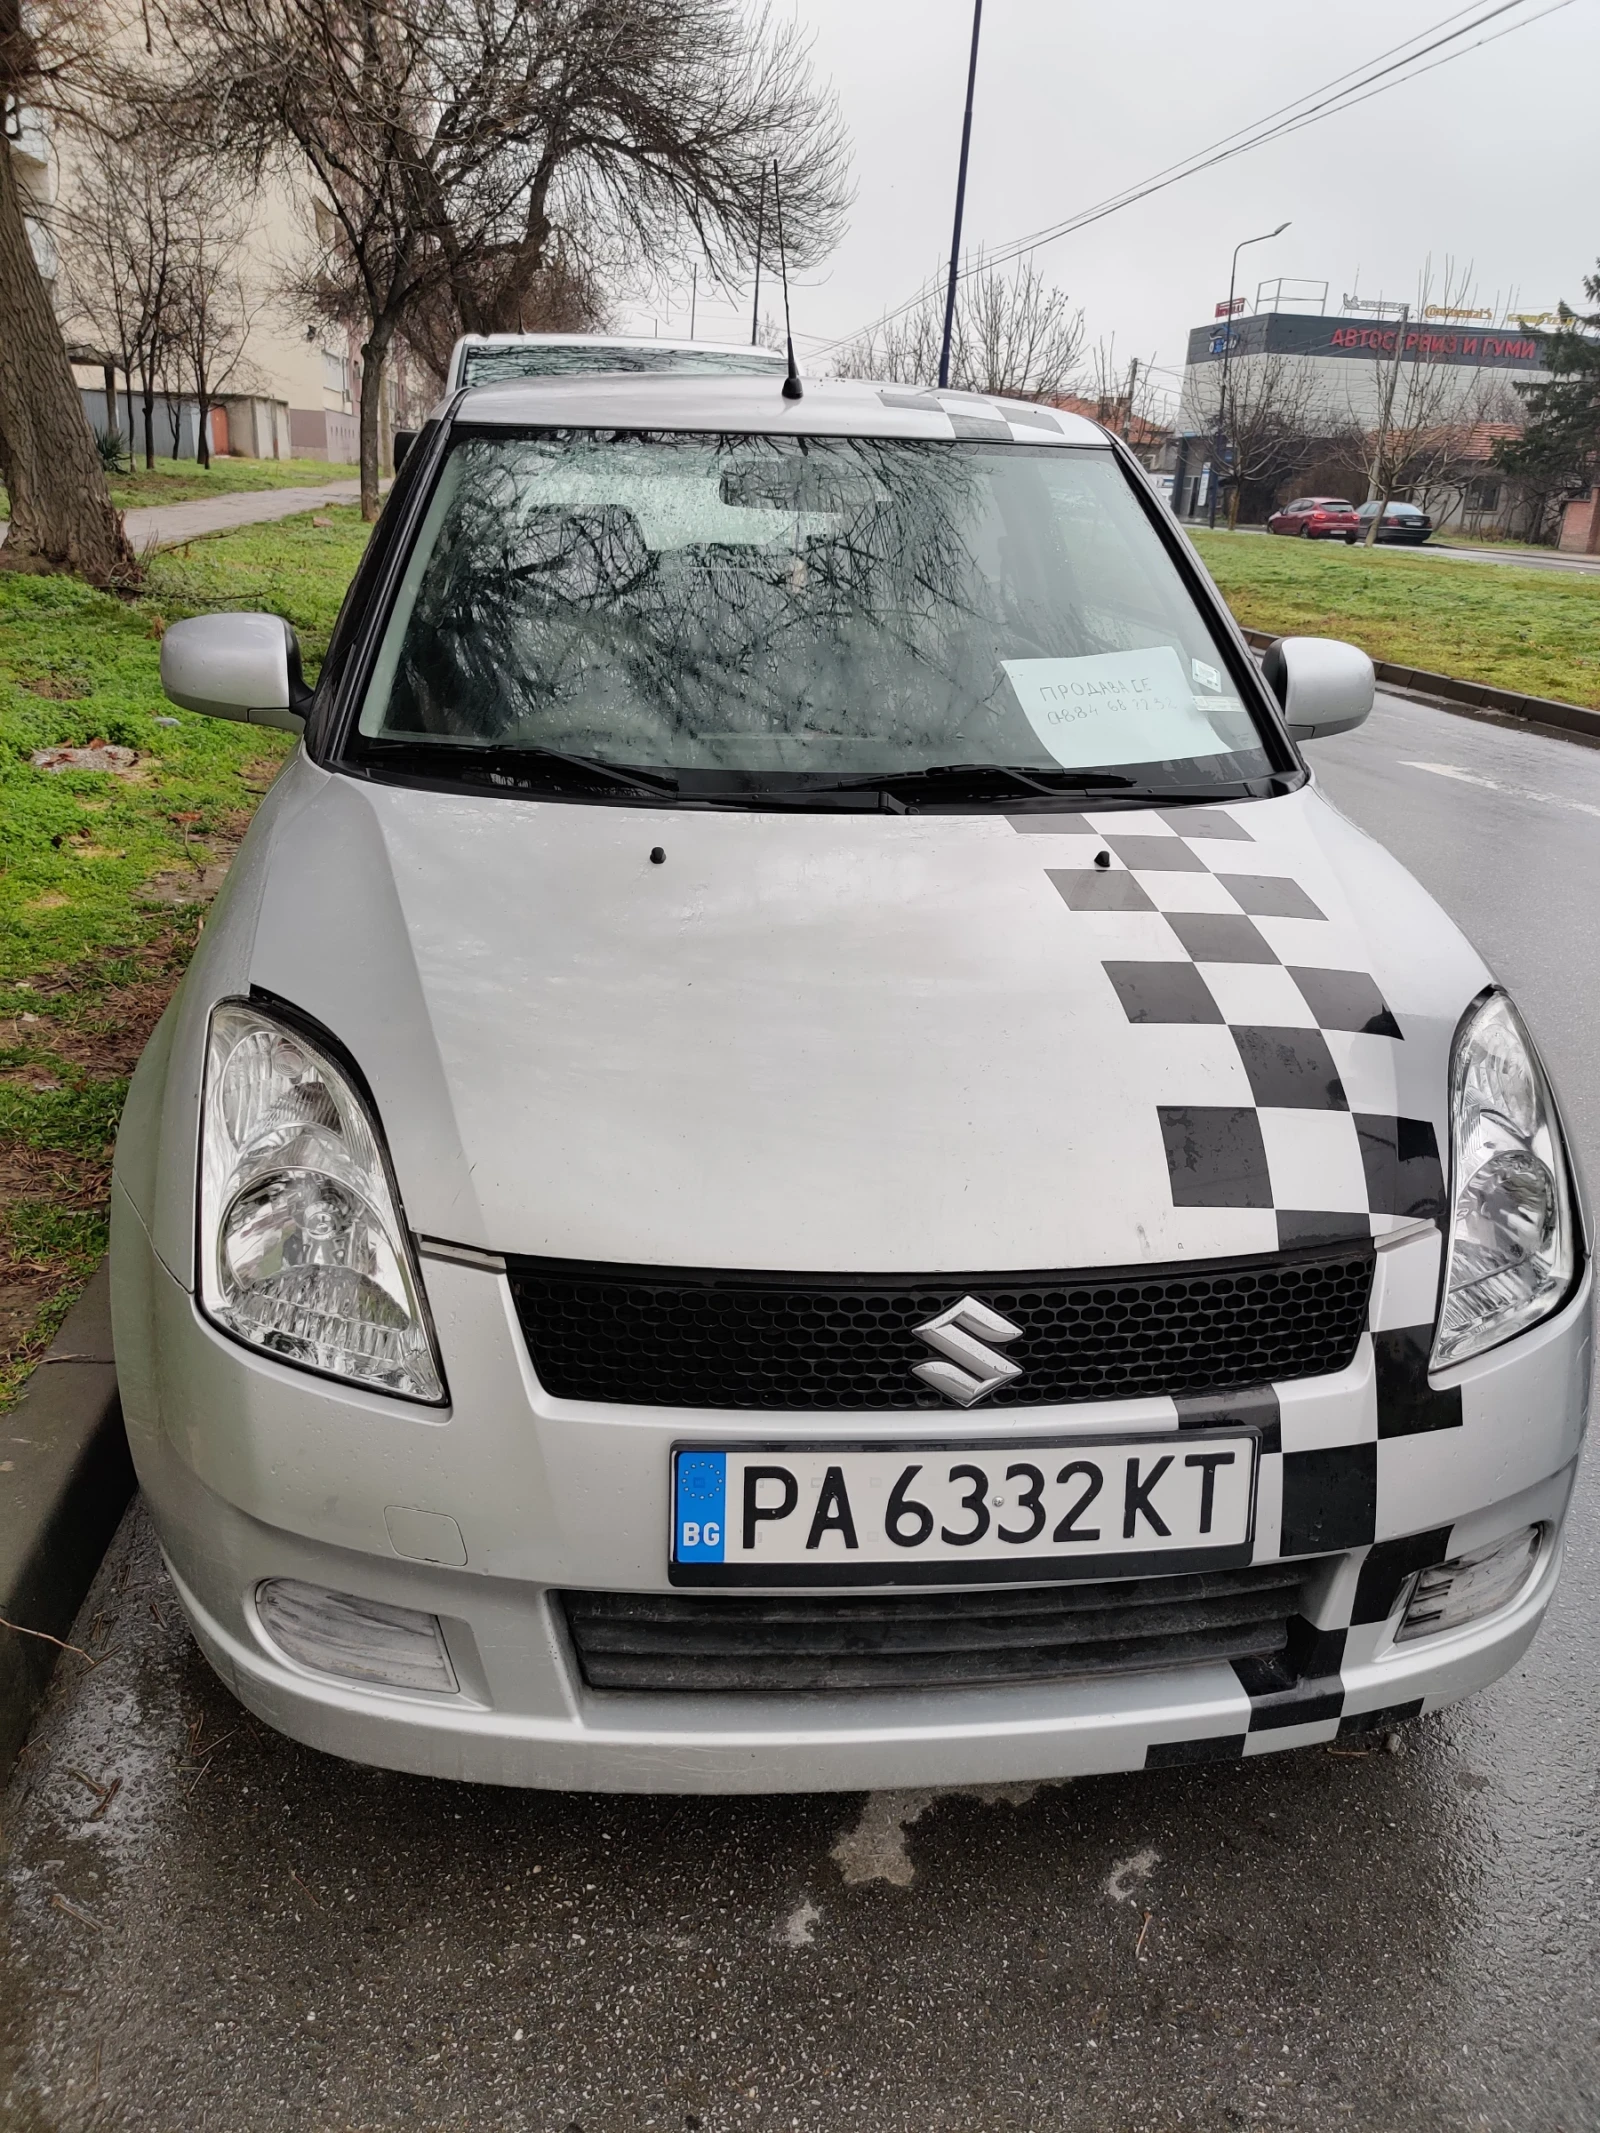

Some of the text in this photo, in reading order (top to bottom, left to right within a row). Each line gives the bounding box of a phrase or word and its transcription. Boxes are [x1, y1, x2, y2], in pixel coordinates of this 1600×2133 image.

[1331, 328, 1536, 360] АВТОСРВИЗ И ГУМИ
[1039, 677, 1152, 702] ПРОДАВА СЕ
[1107, 699, 1127, 712] 68
[742, 1451, 1236, 1550] PA 6332 KT
[682, 1522, 720, 1547] BG
